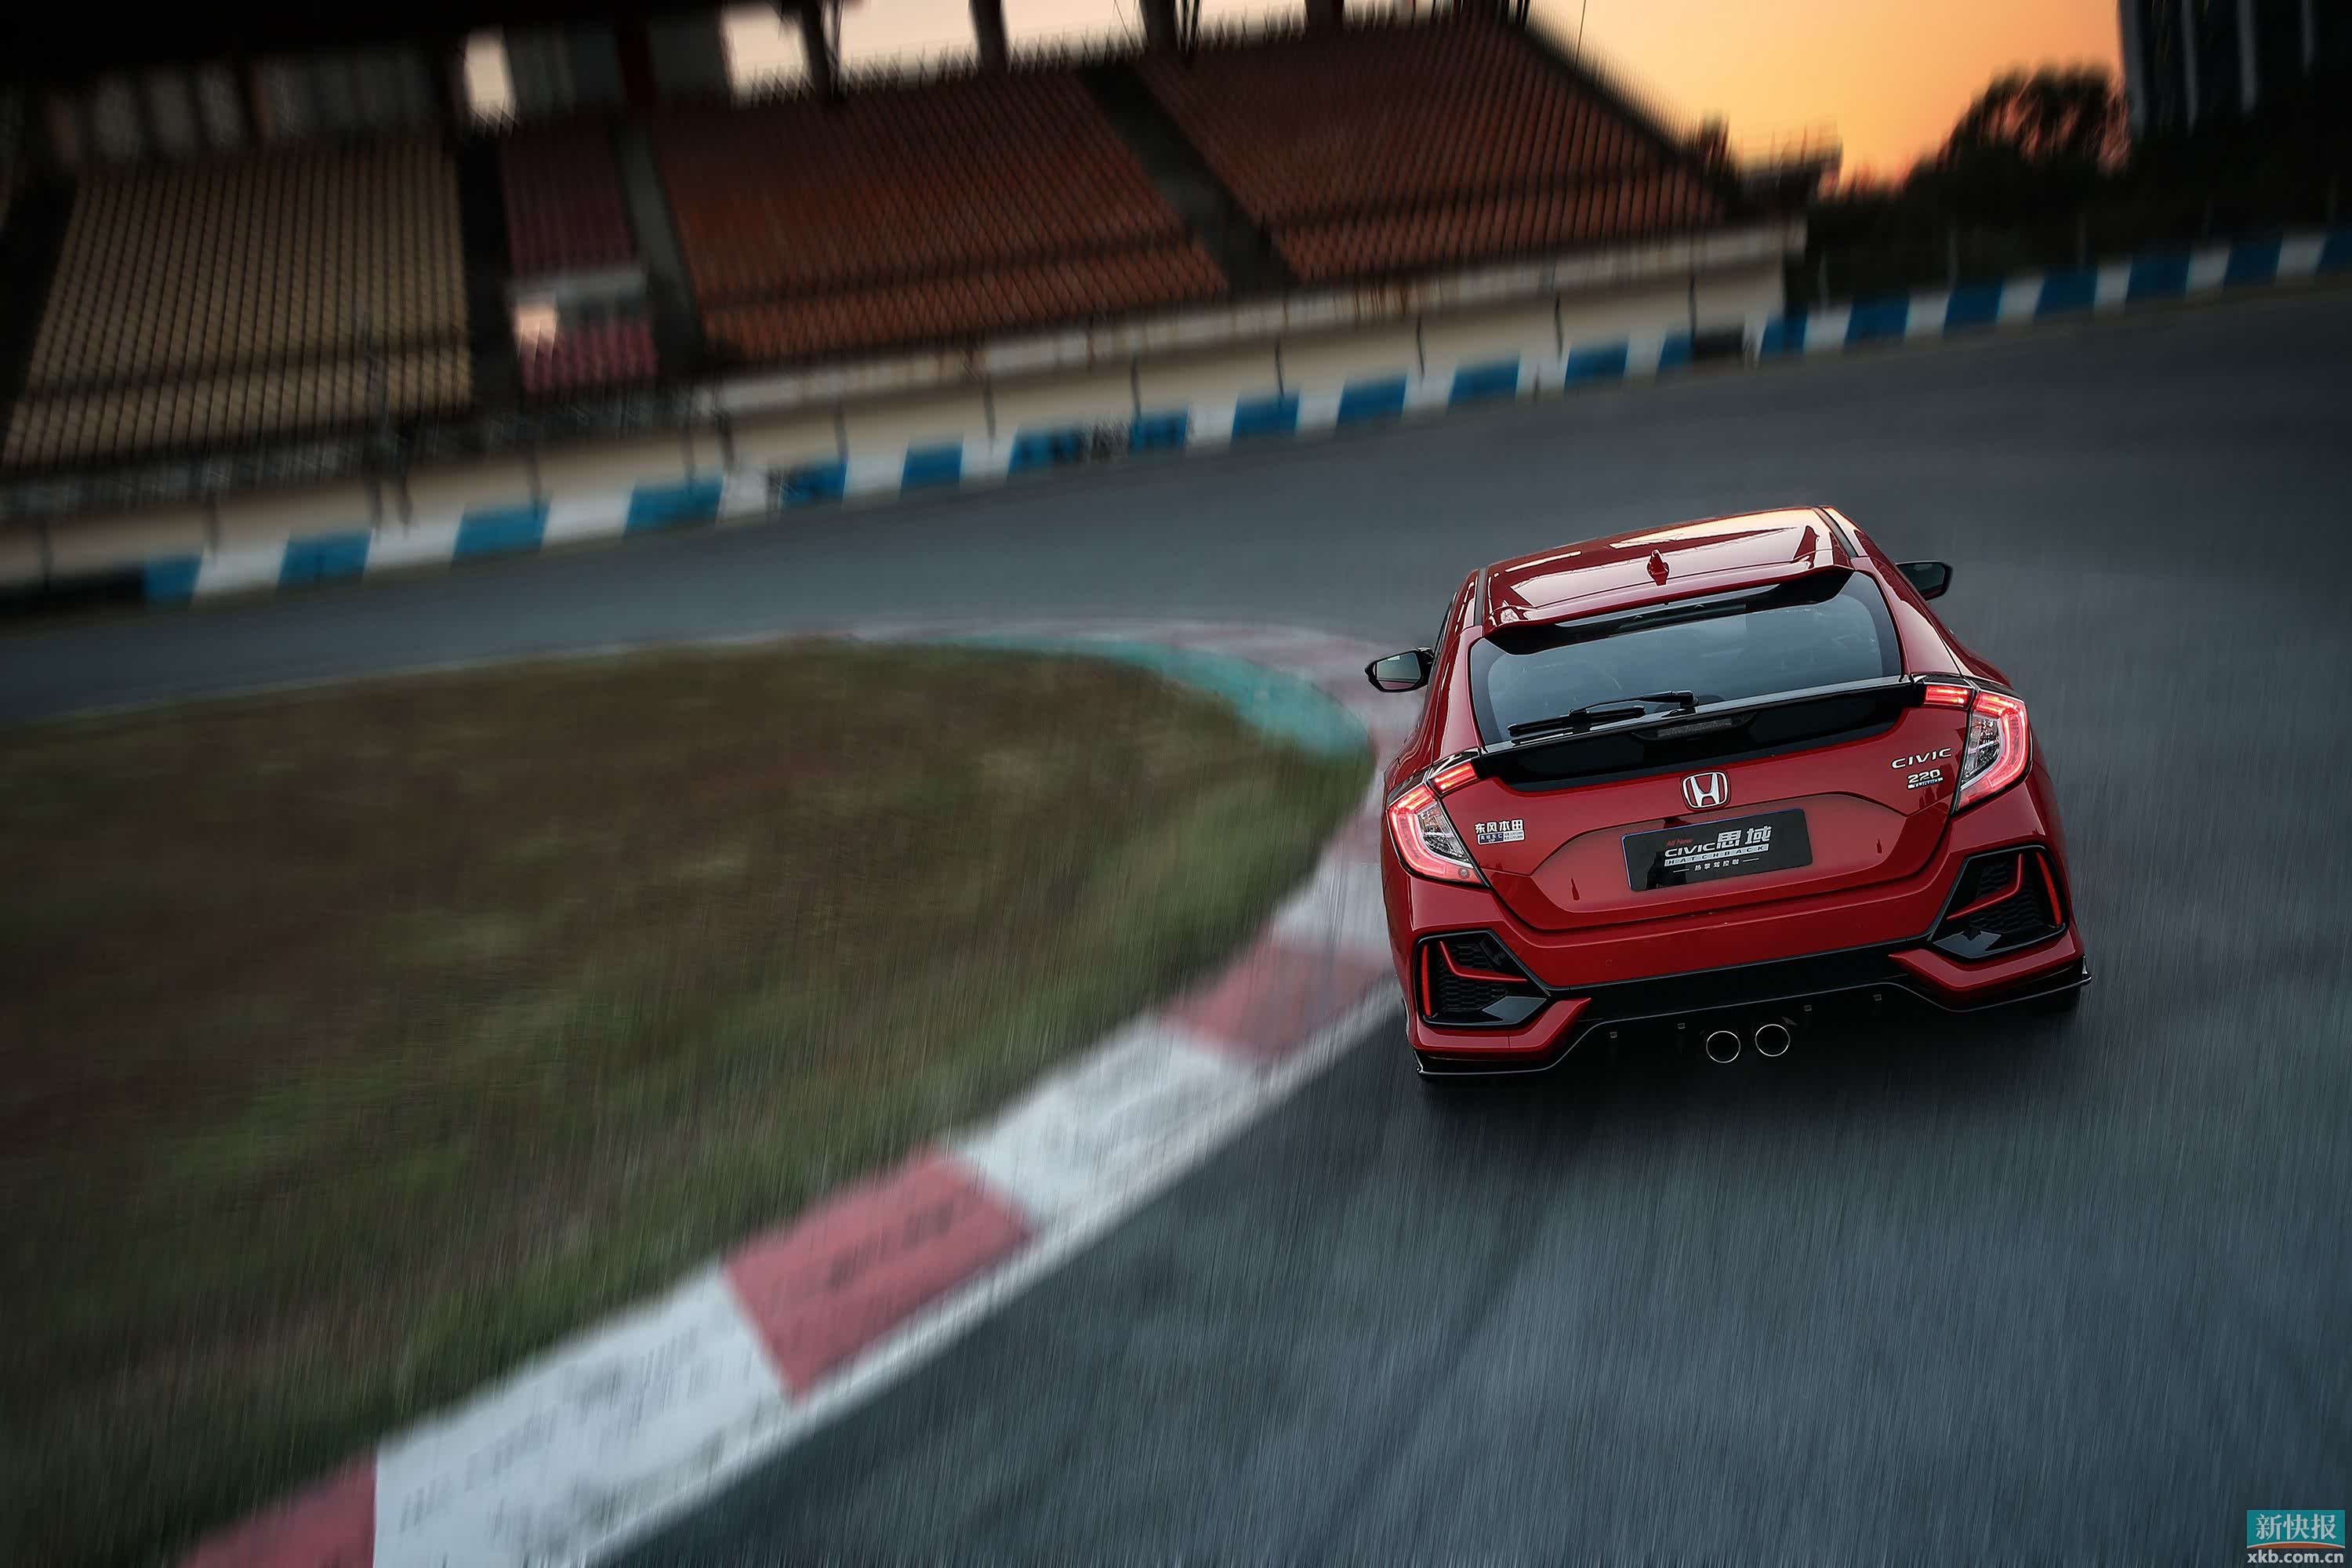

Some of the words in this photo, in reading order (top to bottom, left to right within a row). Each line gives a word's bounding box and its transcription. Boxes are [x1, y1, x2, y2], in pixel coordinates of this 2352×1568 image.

[1892, 748, 1951, 768] CIVIC
[1907, 769, 1940, 783] 220
[1475, 819, 1523, 833] 东风本田
[1664, 842, 1715, 858] CIVIC
[1716, 826, 1772, 849] 思域
[1668, 845, 1765, 865] HATCHBACK
